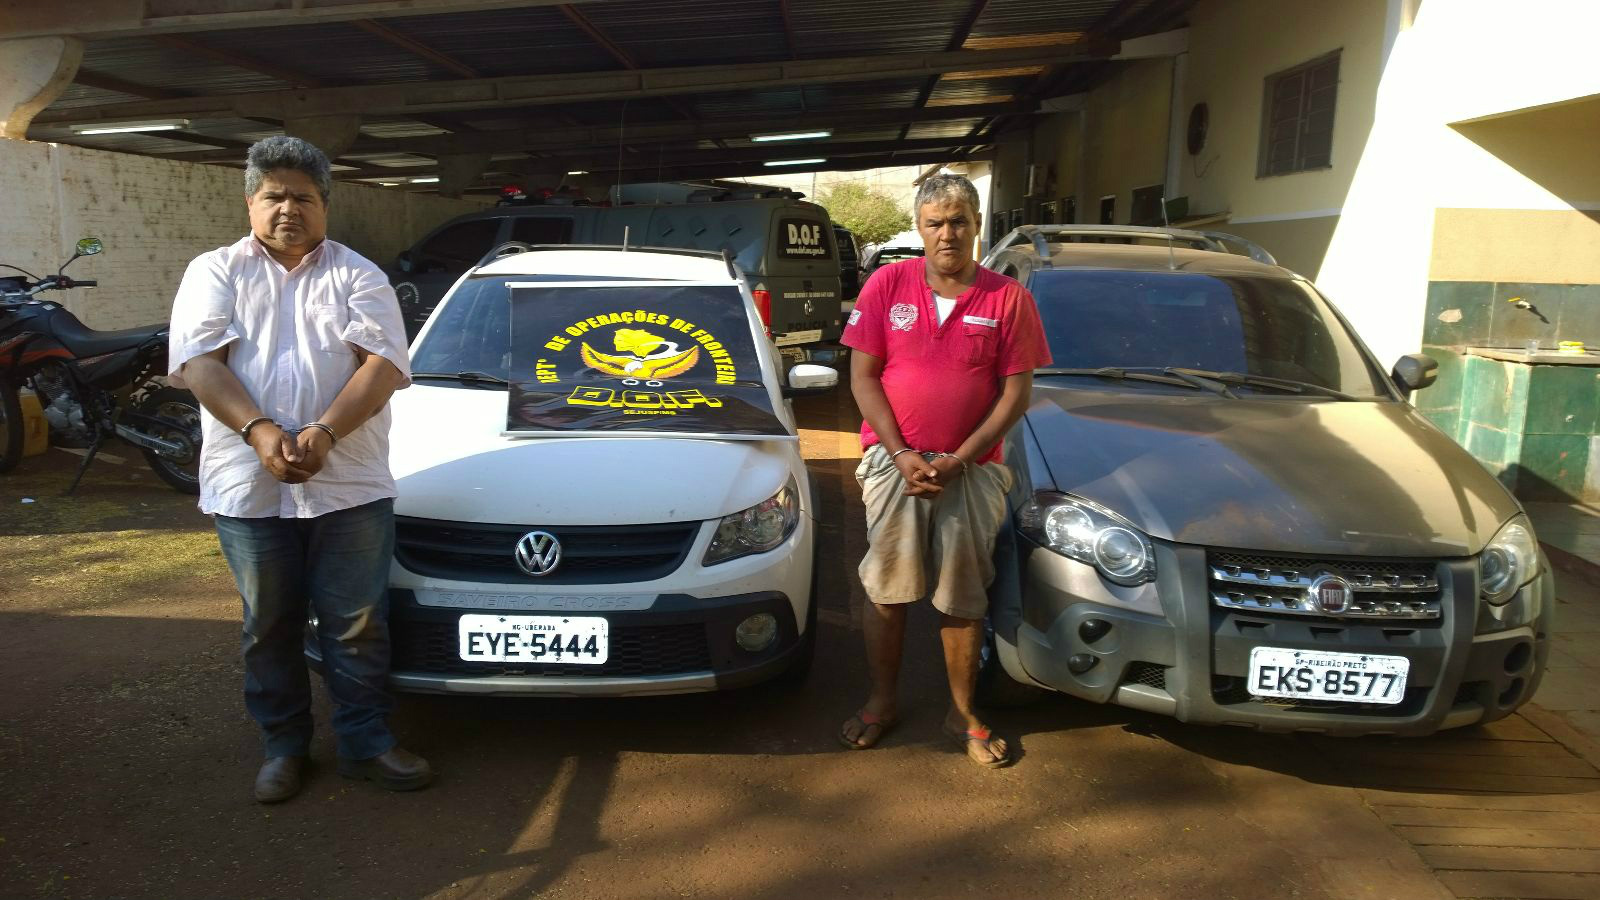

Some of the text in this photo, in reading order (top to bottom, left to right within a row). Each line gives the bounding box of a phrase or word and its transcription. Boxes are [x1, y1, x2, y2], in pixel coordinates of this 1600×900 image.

[787, 223, 821, 246] D.O.F
[544, 335, 572, 352] DE
[564, 309, 670, 337] OPERAÇÕES
[669, 318, 696, 334] DE
[566, 385, 724, 409] D.O.F.
[438, 592, 633, 609] SAVEIRO CROSS
[1322, 588, 1343, 605] FIAT
[1343, 660, 1368, 670] PRETO
